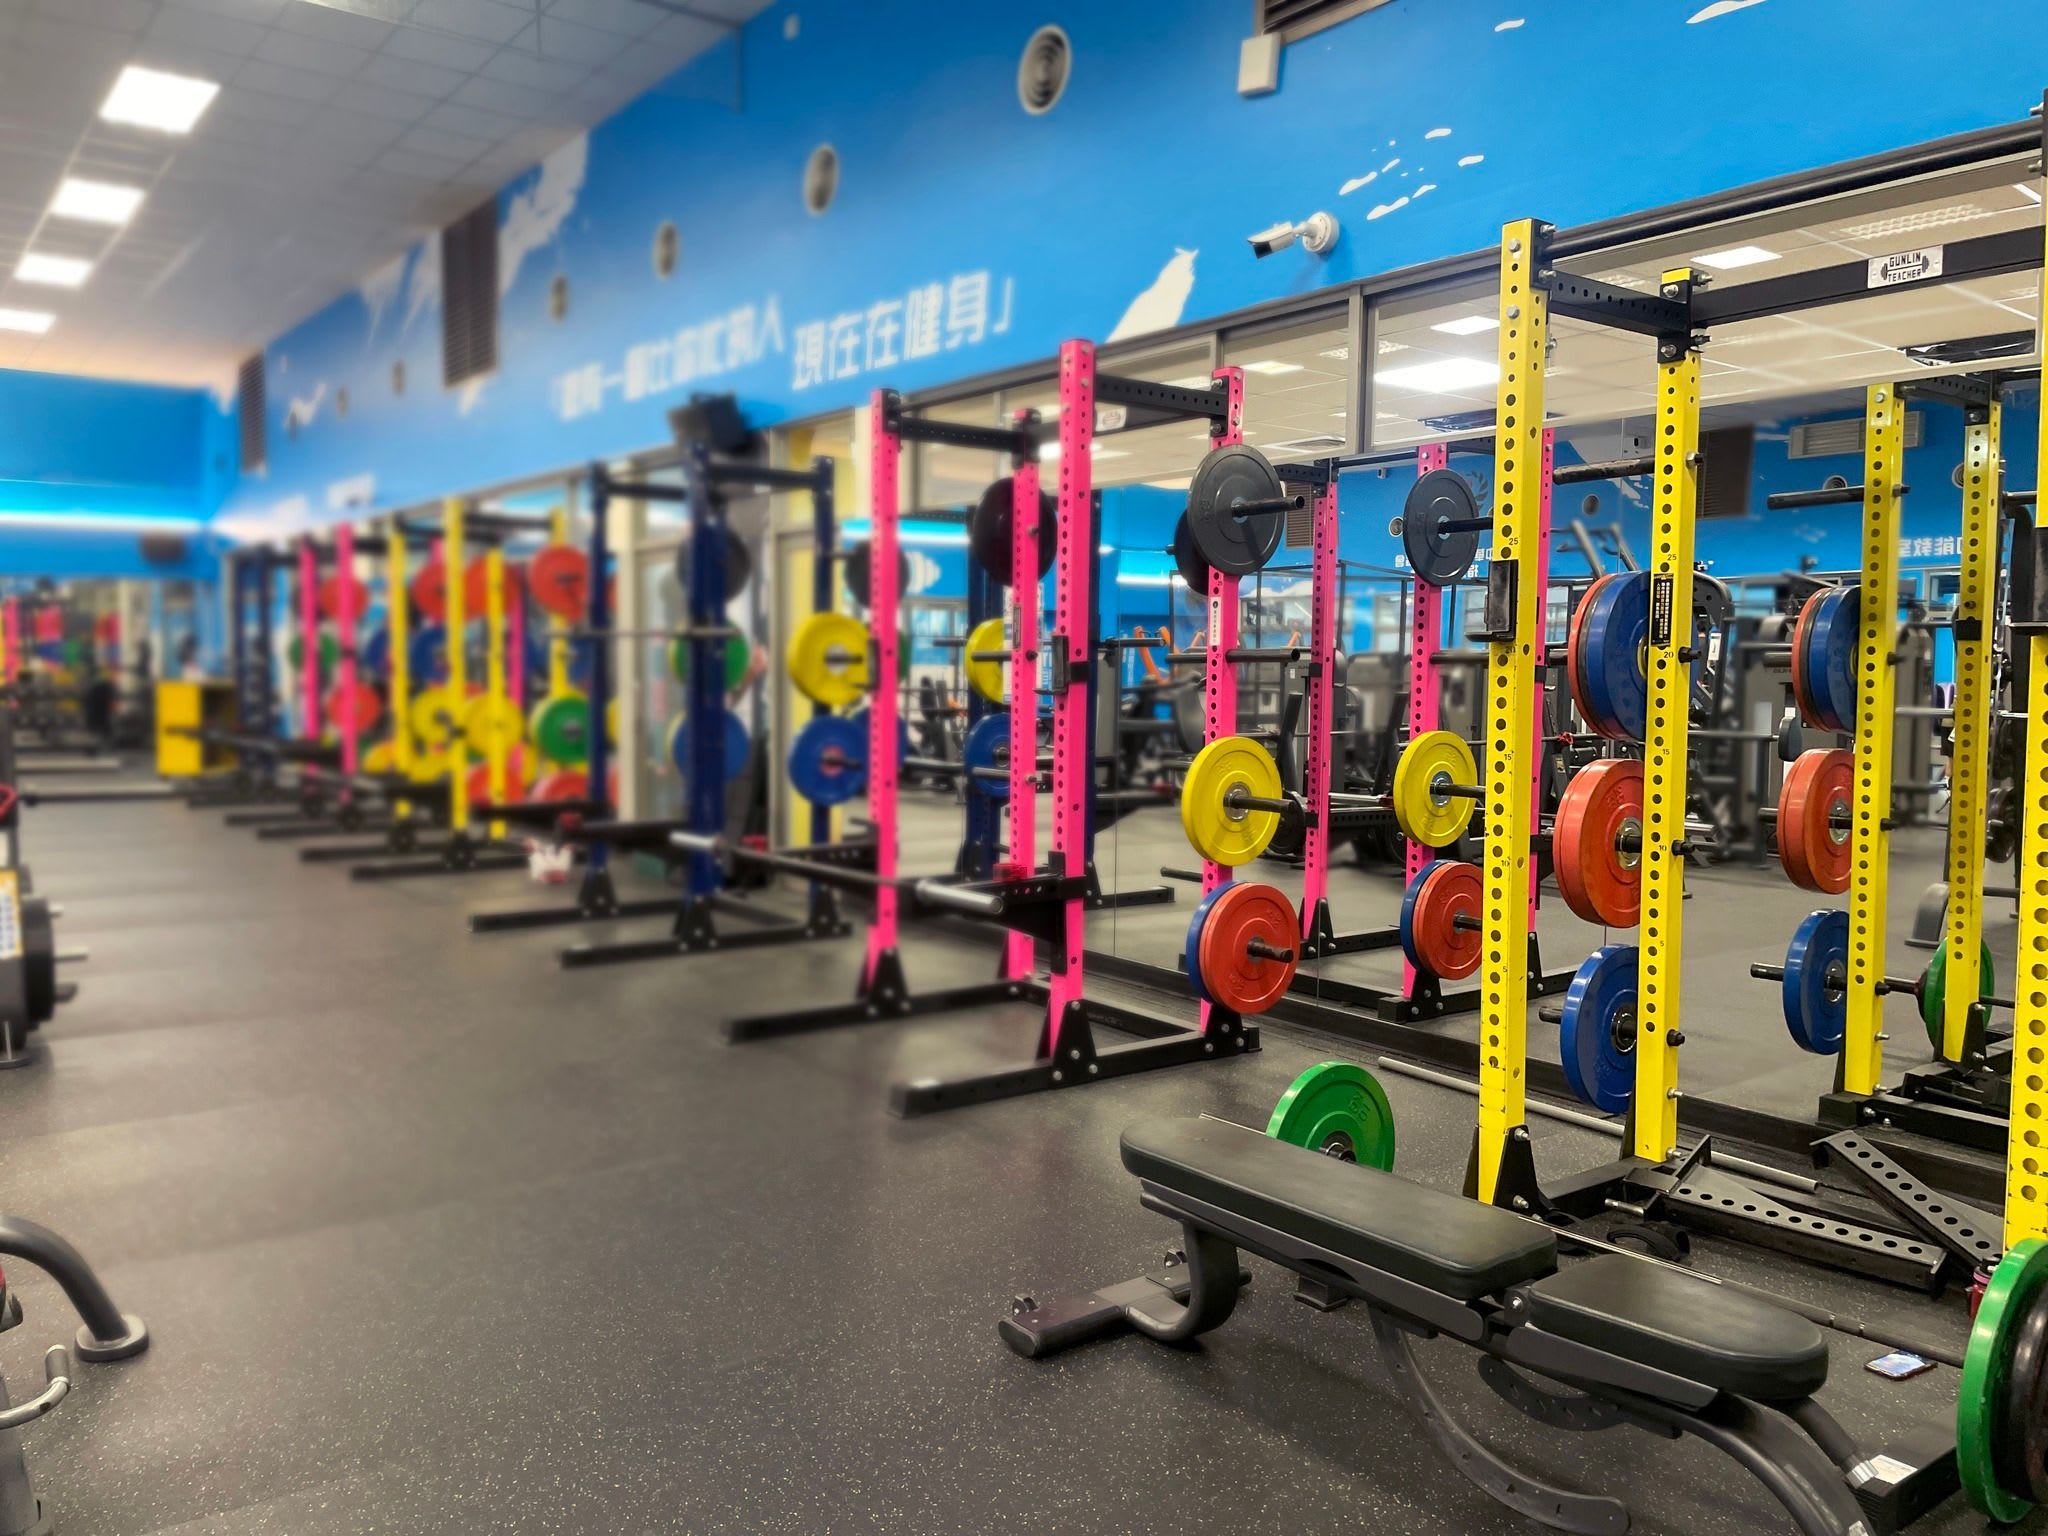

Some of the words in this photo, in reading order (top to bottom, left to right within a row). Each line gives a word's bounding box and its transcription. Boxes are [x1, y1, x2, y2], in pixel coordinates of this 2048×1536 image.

[1889, 251, 1922, 267] GUNLIN
[1888, 268, 1922, 283] TEACHER
[1508, 537, 1519, 546] 25
[1667, 553, 1677, 561] 25
[1664, 651, 1674, 659] 20
[1504, 753, 1512, 761] 15
